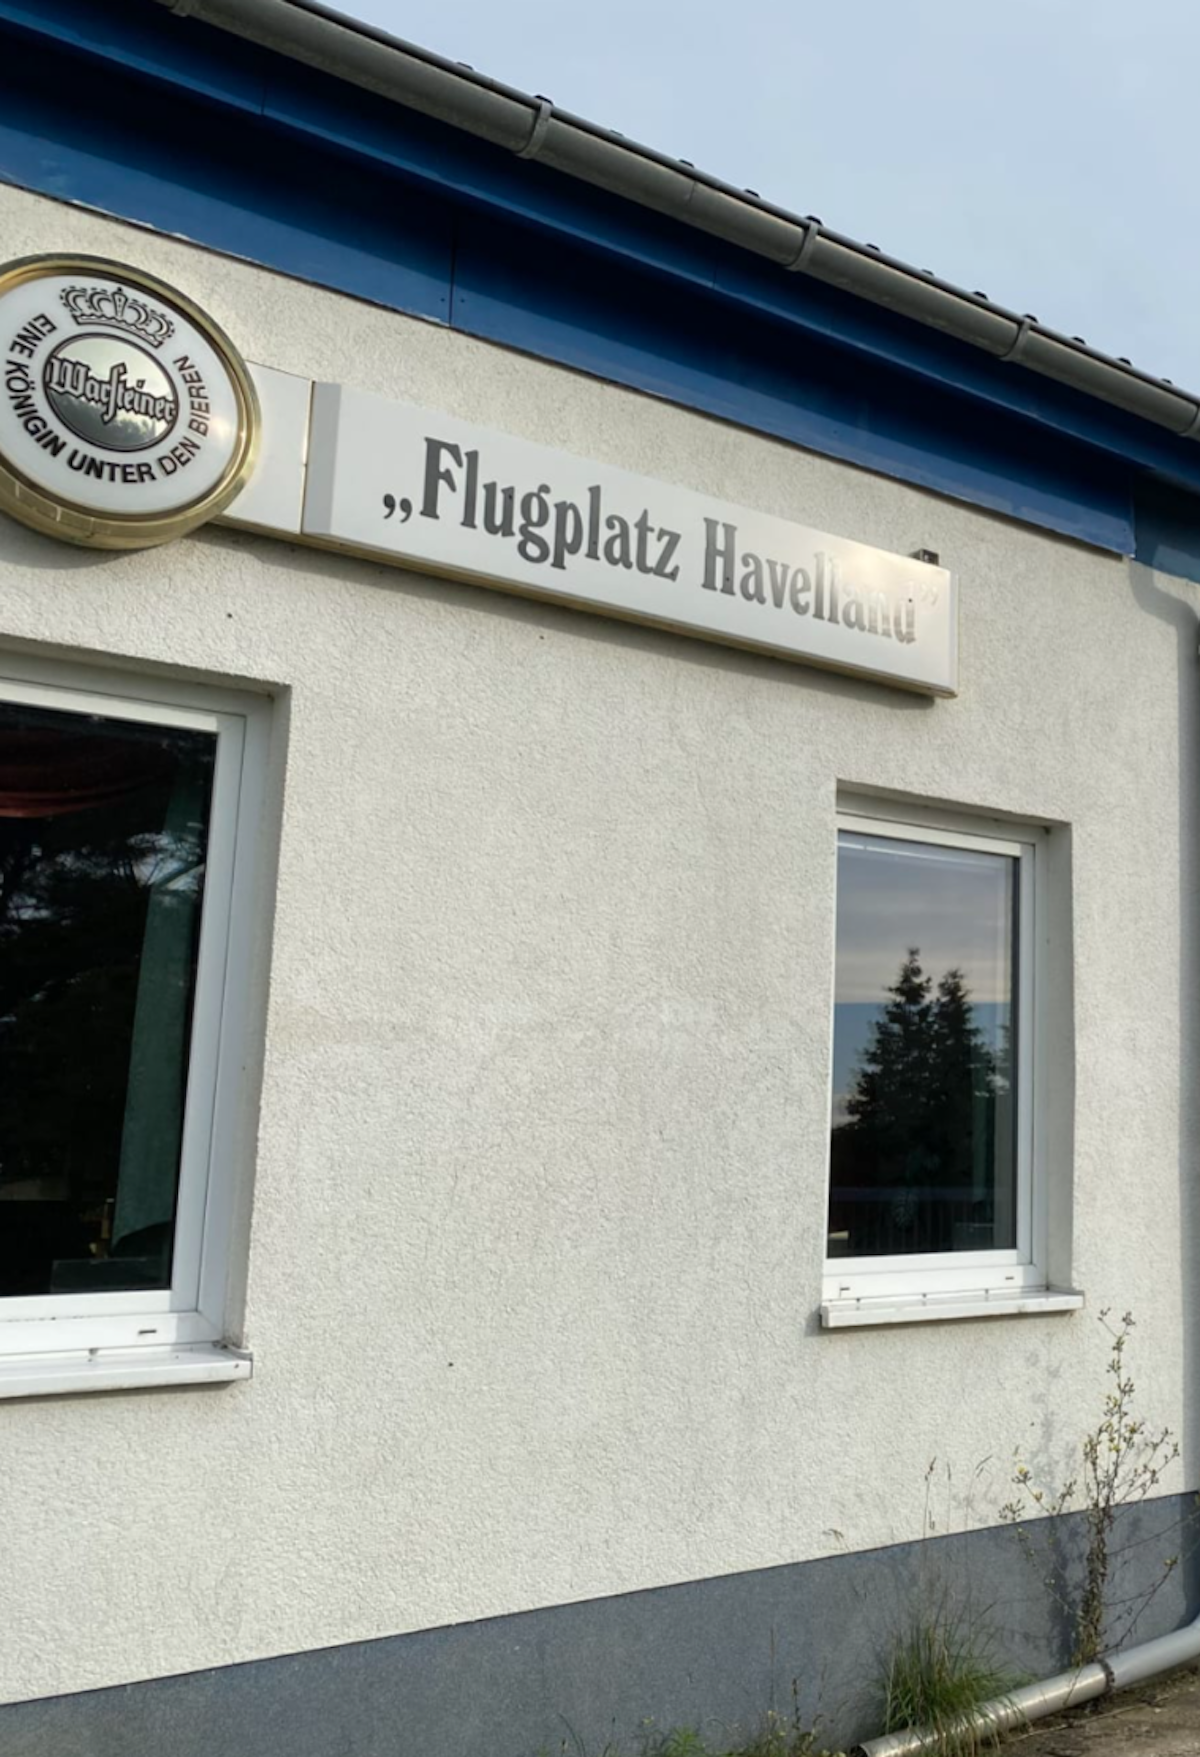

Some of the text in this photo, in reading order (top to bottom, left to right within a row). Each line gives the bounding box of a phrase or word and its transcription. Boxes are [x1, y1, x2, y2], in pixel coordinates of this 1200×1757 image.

[5, 313, 211, 483] EINE KÖNIGIN UNTER DEN BIEREN
